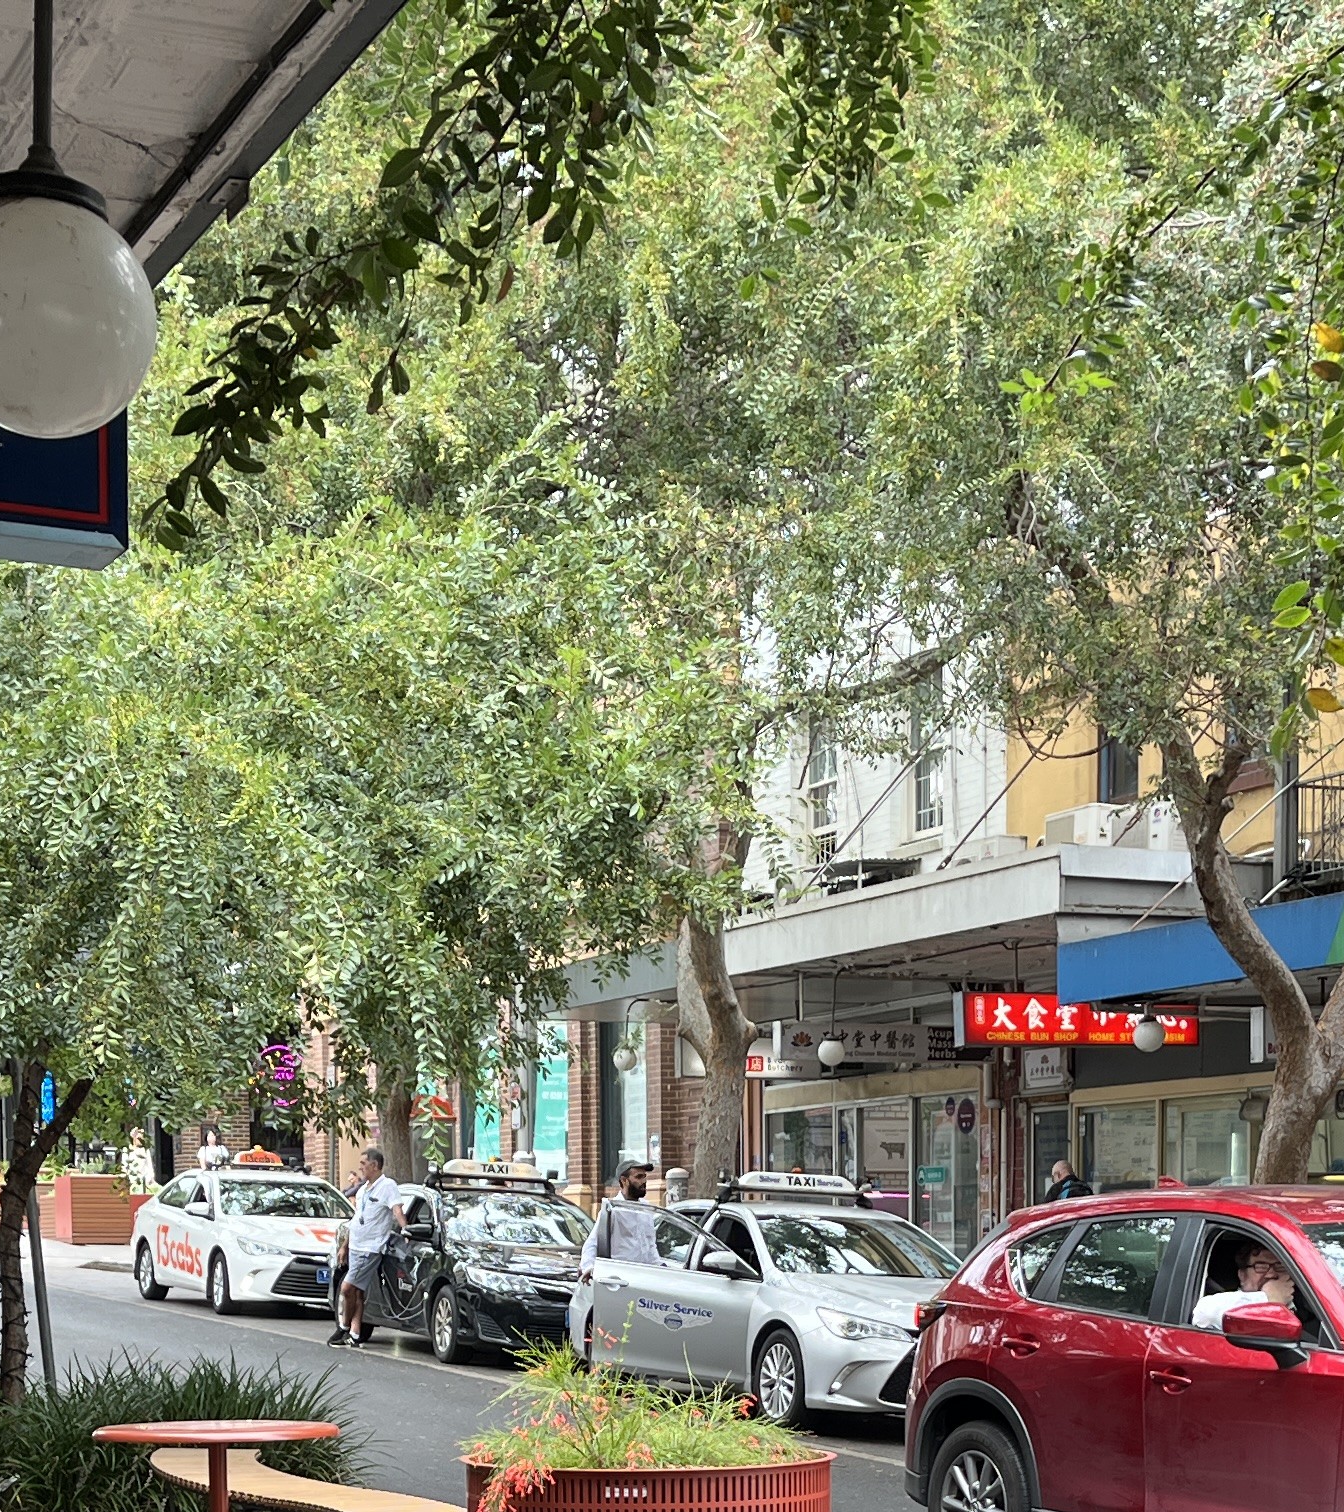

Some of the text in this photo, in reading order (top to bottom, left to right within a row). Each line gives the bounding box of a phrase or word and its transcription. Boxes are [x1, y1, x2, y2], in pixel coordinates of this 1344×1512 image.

[822, 1029, 916, 1049] 中堂中醫館
[928, 1028, 952, 1039] Acup
[986, 1030, 1025, 1042] CHINESE
[1030, 1031, 1049, 1042] BUN
[1054, 1031, 1079, 1042] SHOP
[1088, 1031, 1115, 1042] HOME
[245, 1154, 275, 1164] 13cabs
[481, 1163, 509, 1174] TAXI
[786, 1176, 816, 1187] TAXI
[157, 1224, 203, 1278] 13cabs
[638, 1298, 713, 1318] Silver Service
